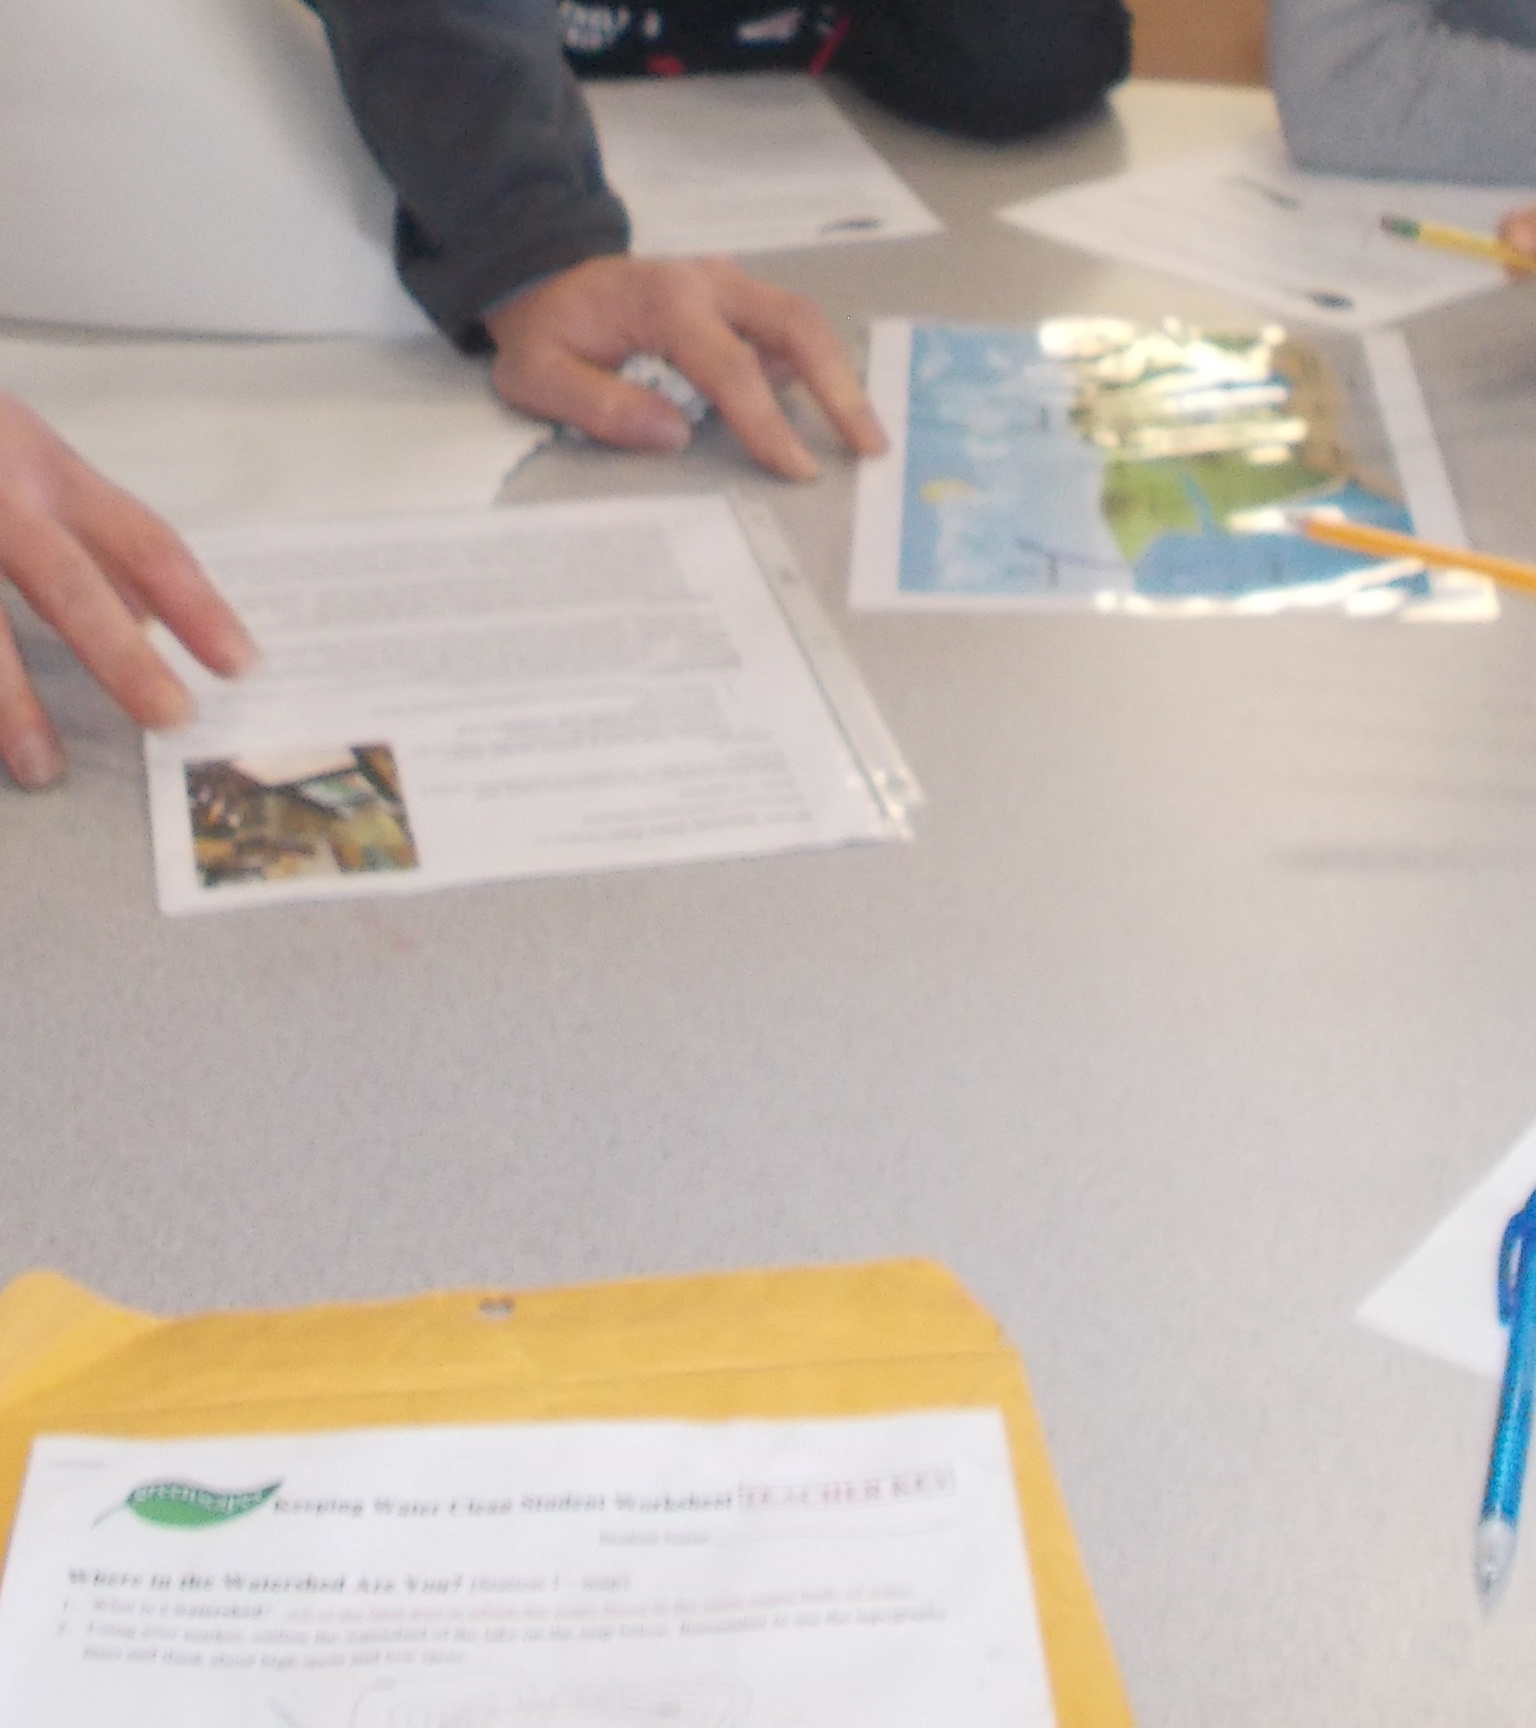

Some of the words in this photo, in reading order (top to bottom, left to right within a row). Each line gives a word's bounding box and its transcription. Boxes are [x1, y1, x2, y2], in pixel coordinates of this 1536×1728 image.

[274, 1496, 364, 1519] Keeping
[373, 1496, 440, 1518] Water
[521, 1492, 606, 1516] Student
[614, 1490, 733, 1515] Worksheet
[68, 1566, 145, 1587] Where
[151, 1569, 171, 1589] in
[178, 1570, 214, 1590] the
[223, 1570, 347, 1593] Watershed
[357, 1573, 395, 1593] Are
[405, 1572, 462, 1595] You?
